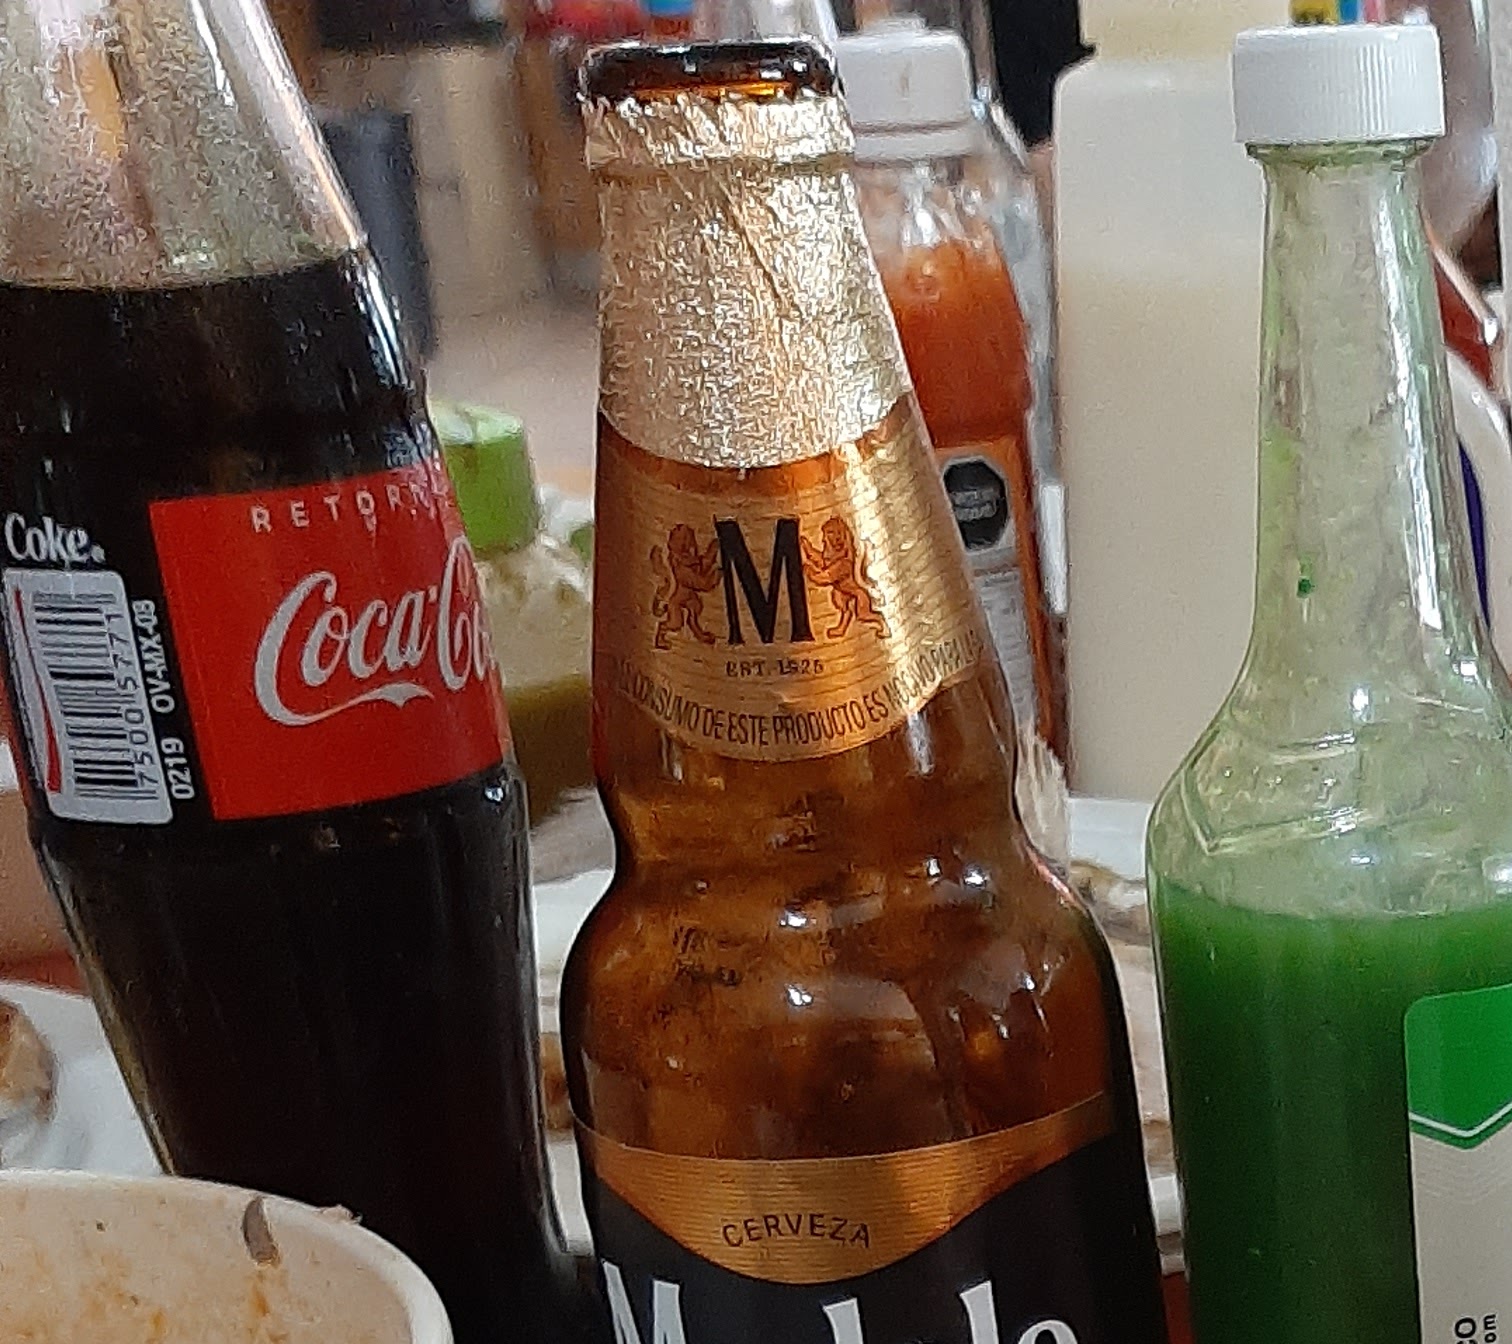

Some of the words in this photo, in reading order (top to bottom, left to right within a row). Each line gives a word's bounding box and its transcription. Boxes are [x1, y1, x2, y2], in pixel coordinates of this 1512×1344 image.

[251, 480, 437, 533] RETORN
[714, 515, 815, 645] M
[703, 707, 726, 740] DE
[727, 711, 769, 746] ESTE
[773, 700, 866, 746] PRODUCTO
[863, 688, 889, 723] ES
[161, 737, 196, 799] 0219
[722, 1211, 871, 1249] CERVEZA
